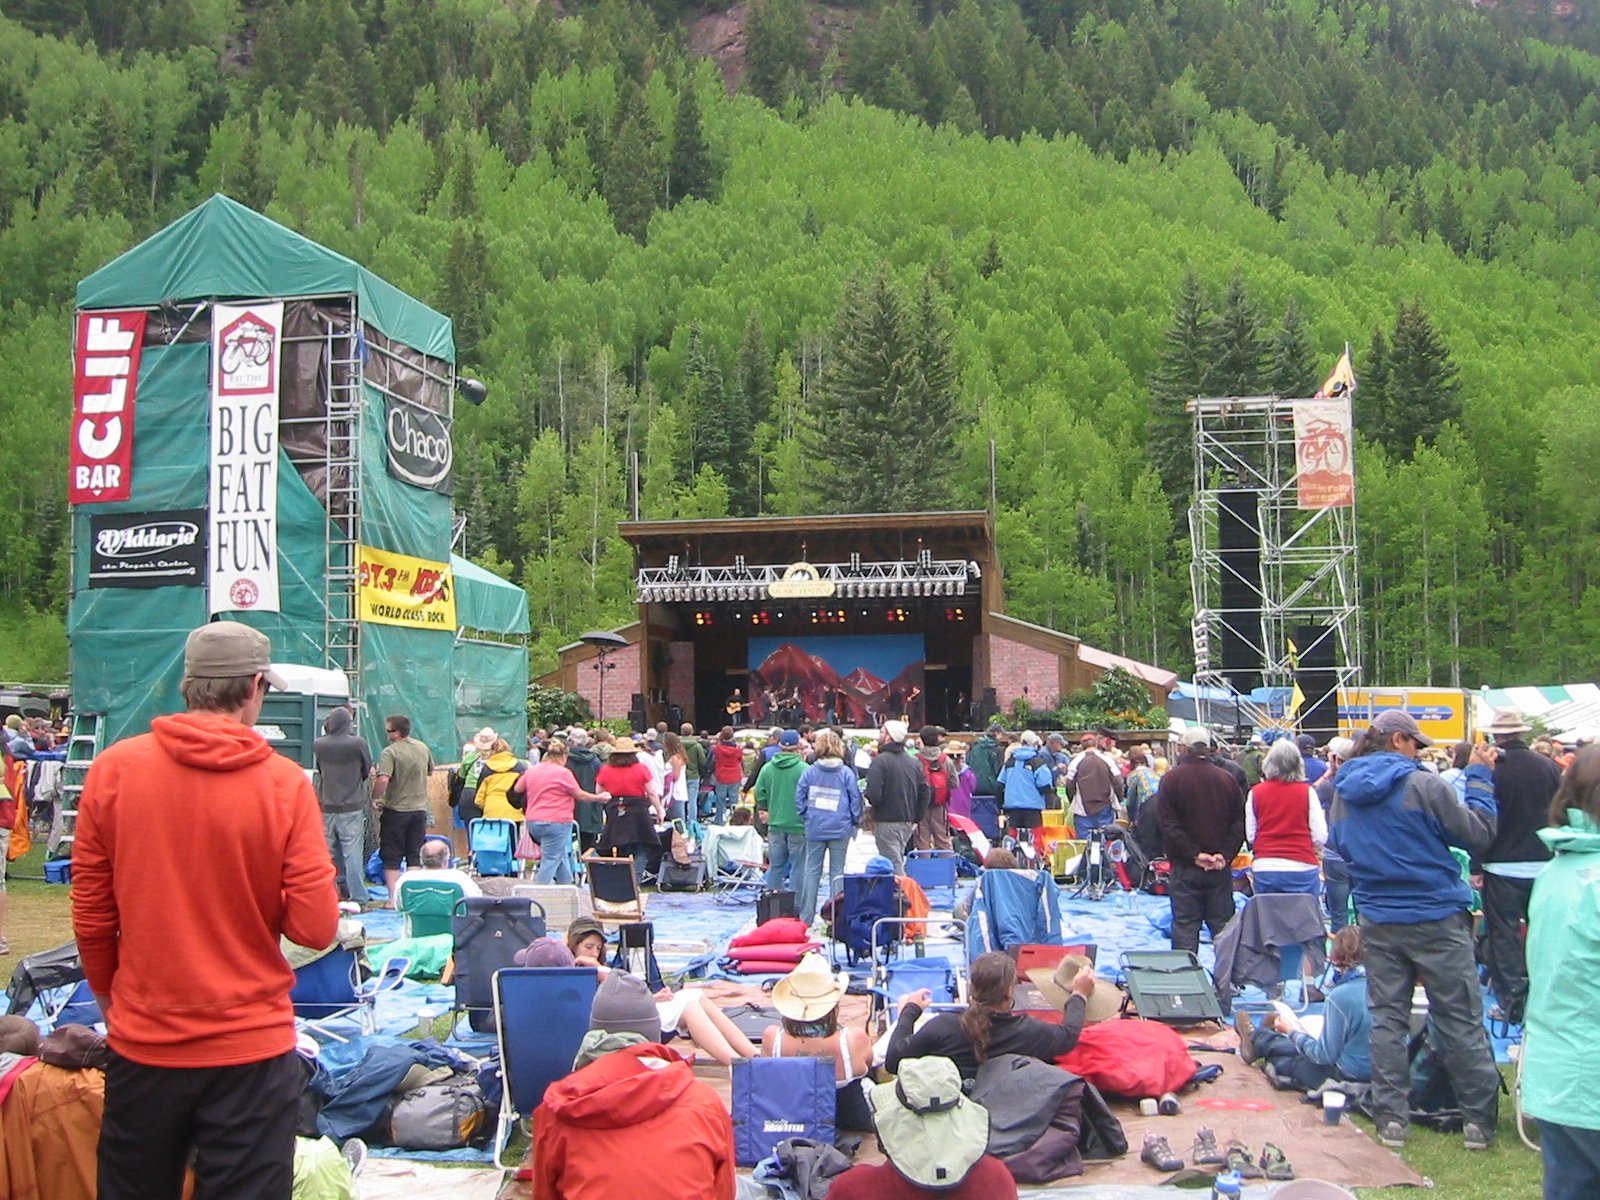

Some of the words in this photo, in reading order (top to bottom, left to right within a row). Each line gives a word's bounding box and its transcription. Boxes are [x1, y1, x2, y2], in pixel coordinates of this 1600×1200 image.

[78, 317, 135, 460] CLIF
[217, 403, 273, 456] BIG
[388, 407, 448, 464] Chaco
[76, 464, 122, 489] BAR
[217, 460, 272, 514] FAT
[97, 526, 195, 555] D'Addario
[216, 518, 271, 572] FUN
[370, 603, 402, 619] WORLD
[402, 608, 425, 622] CLASS
[427, 610, 445, 624] ROCK
